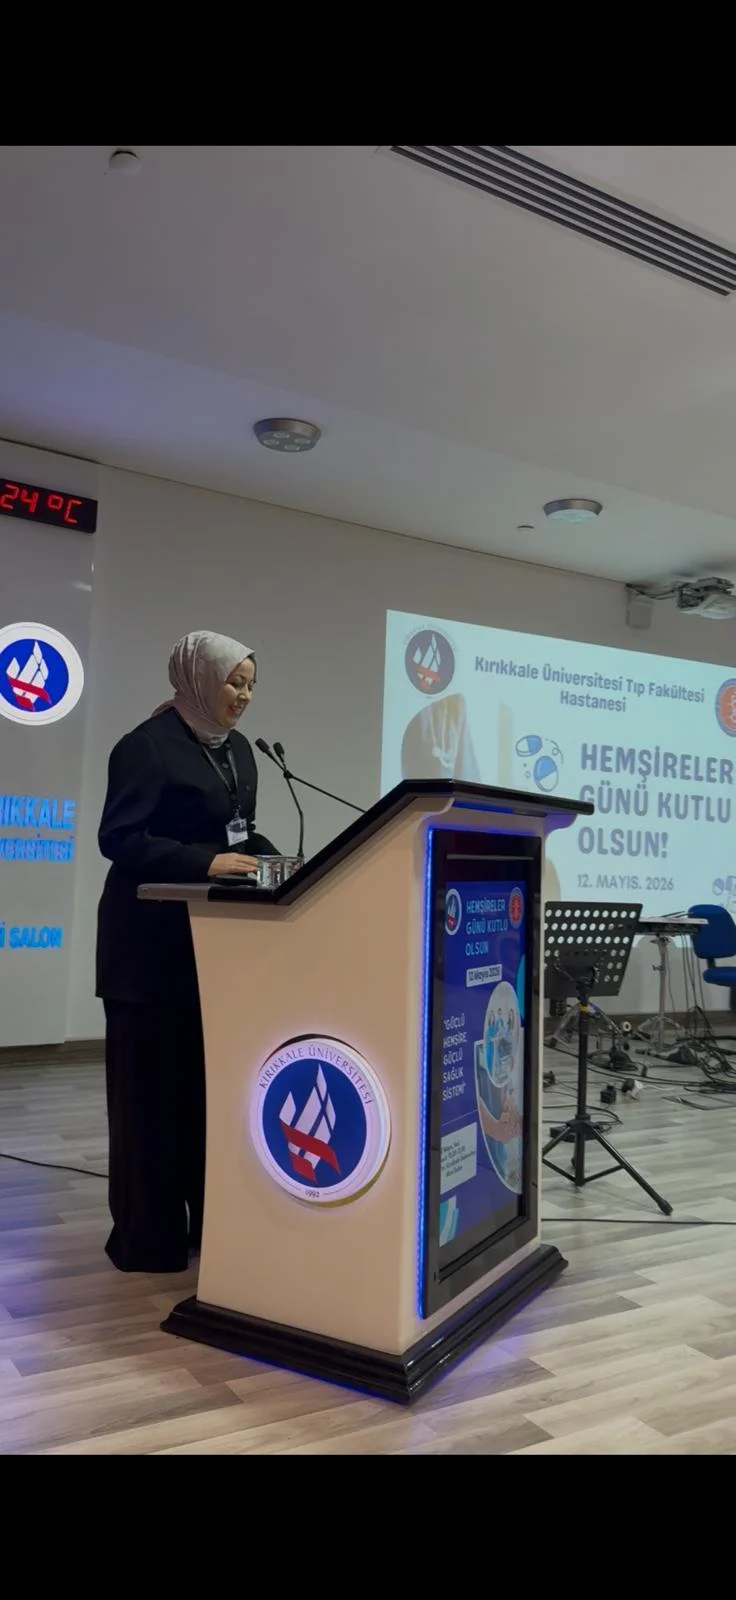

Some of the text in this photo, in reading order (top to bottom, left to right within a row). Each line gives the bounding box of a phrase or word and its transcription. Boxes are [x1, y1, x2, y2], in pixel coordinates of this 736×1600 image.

[0, 484, 39, 513] 24
[474, 655, 705, 703] Kırıkkale Üniversitesi Tıp Fakültesi
[560, 690, 627, 712] Hastanesi
[580, 743, 734, 785] HEMŞİRELER
[579, 780, 732, 823] GÜNÜ KUTLU
[578, 826, 669, 858] OLSUN!
[577, 874, 675, 891] 12. MAYIS. 2026
[466, 897, 506, 913] HEMŞİRELER
[9, 926, 63, 948] SALON
[465, 918, 508, 935] GÜNÜ KUTLU
[465, 940, 489, 956] OLSUN
[443, 1048, 464, 1066] GÜÇLÜ
[259, 1044, 375, 1105] KIRIKKALE ÜNİVERSİTESİ
